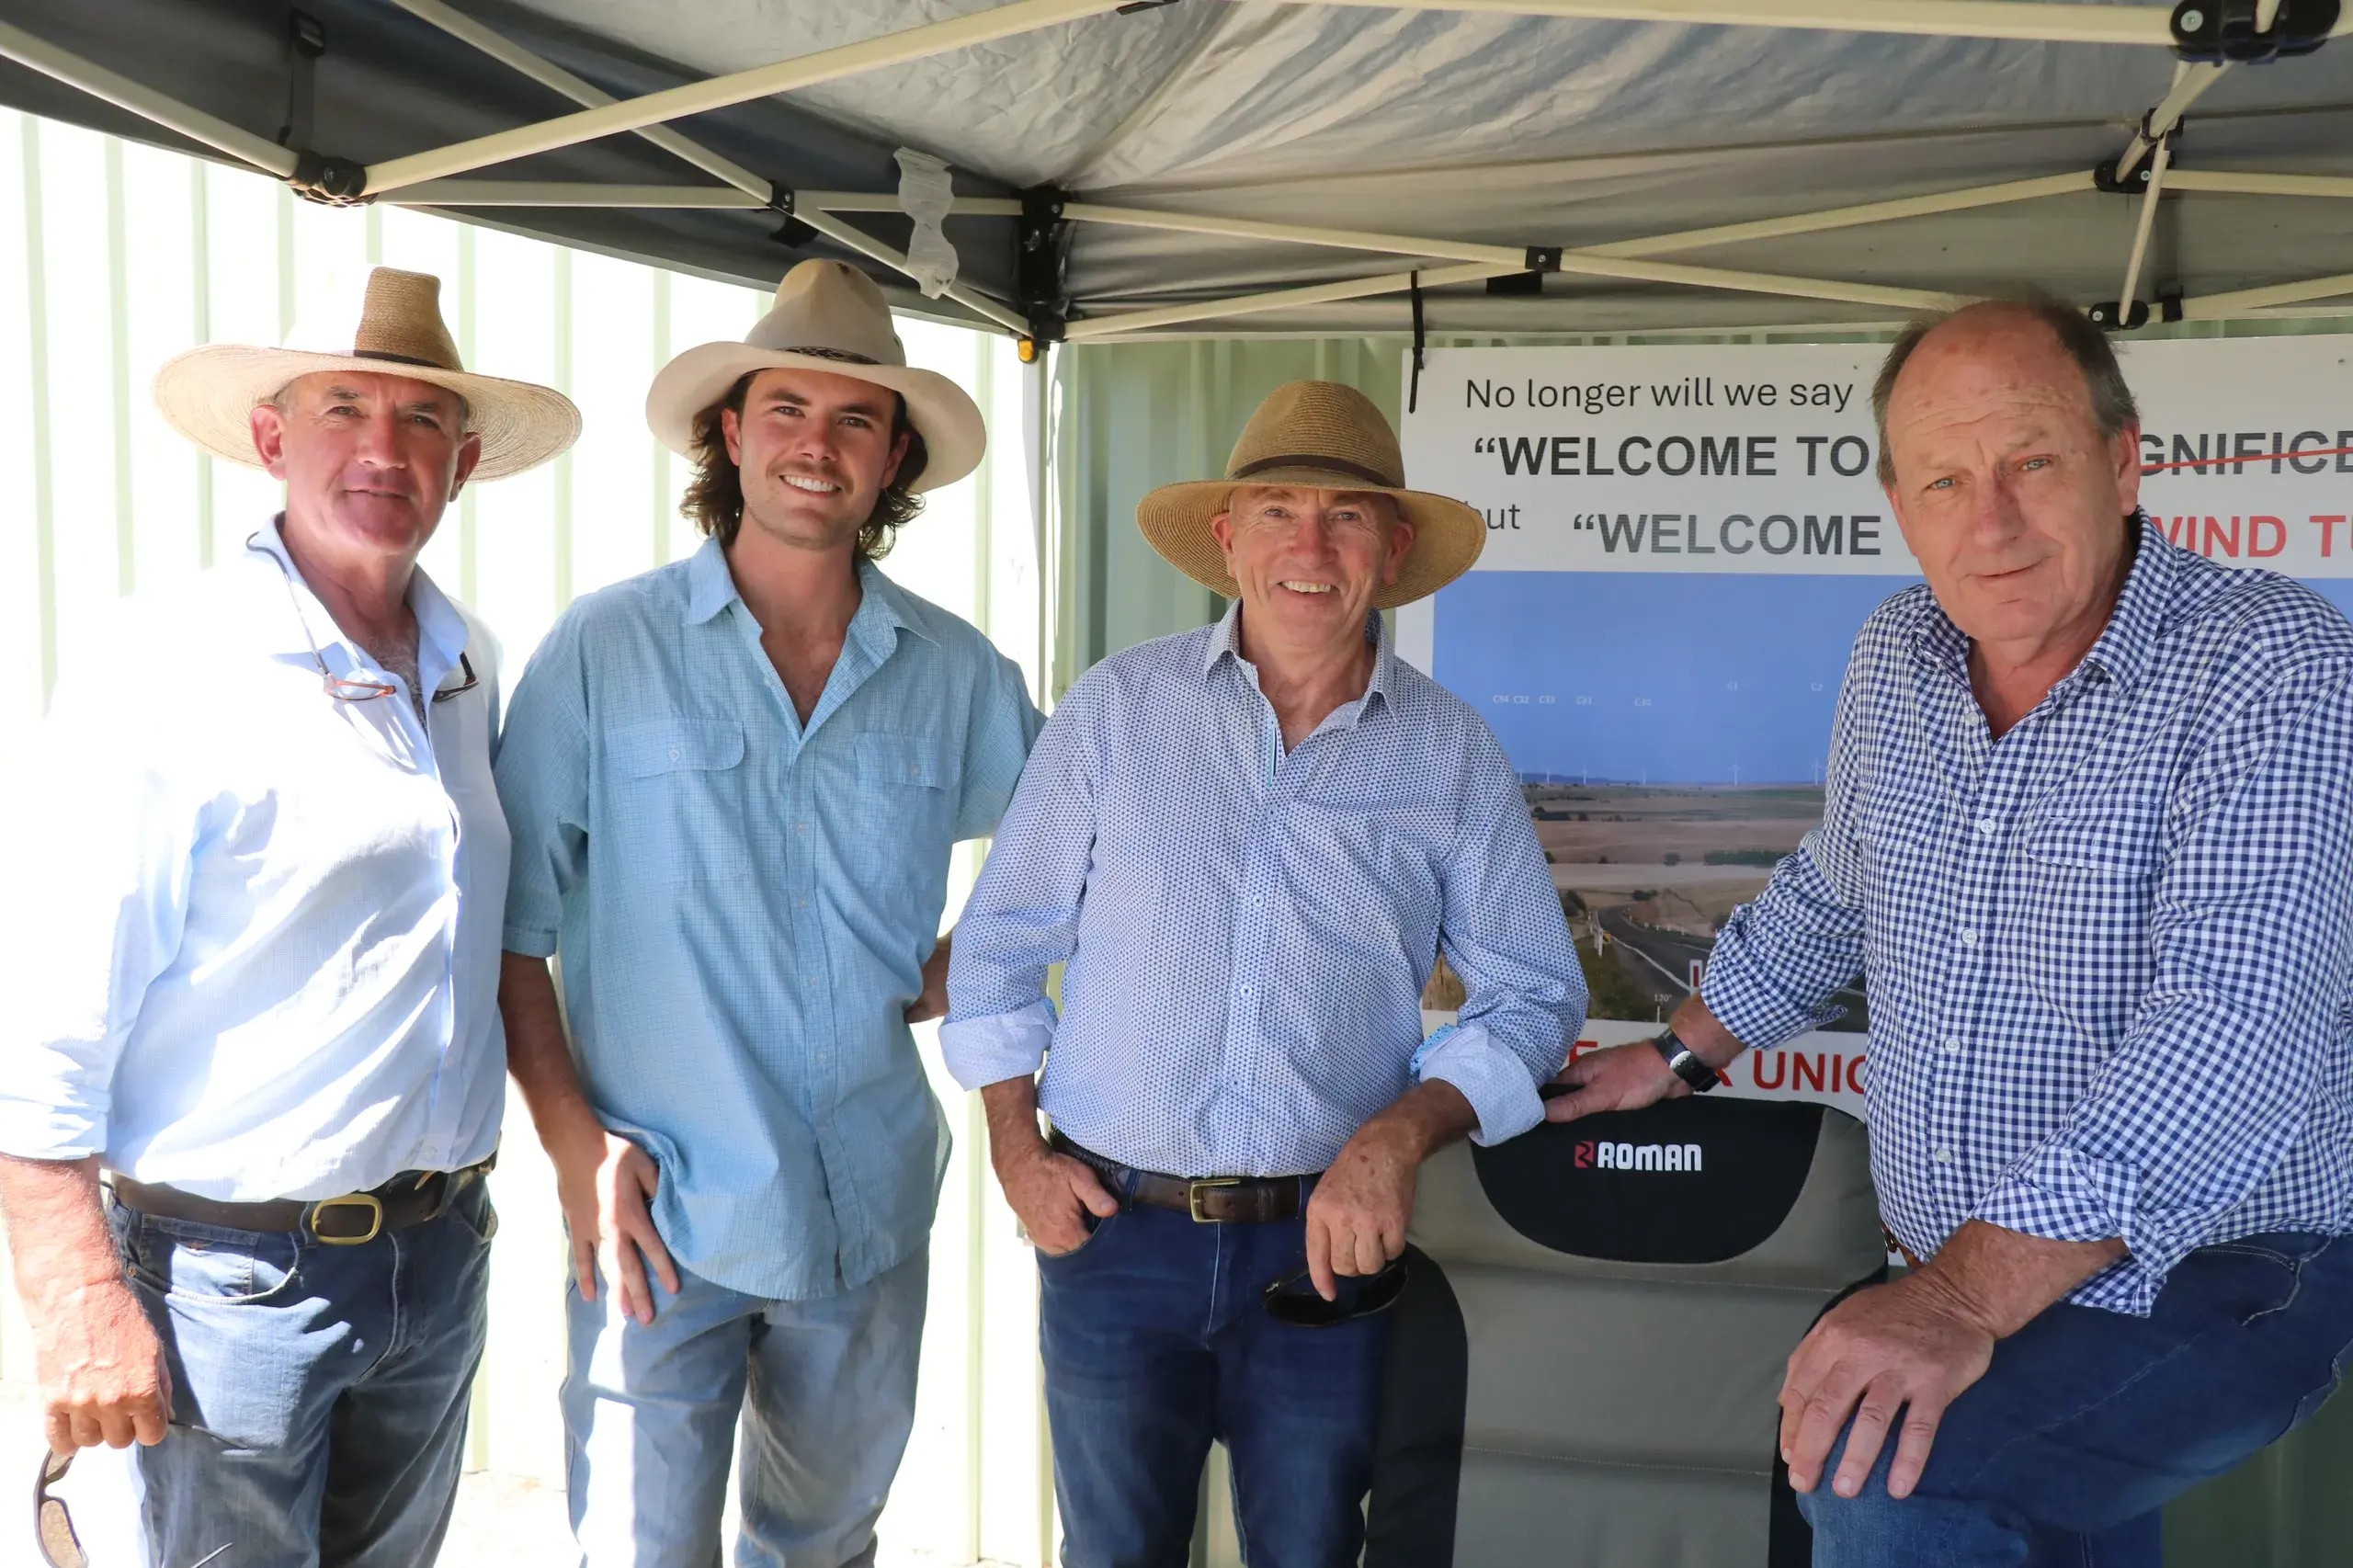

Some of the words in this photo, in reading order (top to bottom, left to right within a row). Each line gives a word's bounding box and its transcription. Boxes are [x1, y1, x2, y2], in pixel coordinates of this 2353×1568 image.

[1466, 379, 1516, 408] No
[1527, 379, 1642, 415] longer
[1651, 377, 1714, 407] will
[1724, 382, 1778, 407] we
[1789, 382, 1854, 413] say
[1474, 436, 1778, 477] “WELCOME
[1796, 436, 1870, 477] TO
[1464, 501, 1521, 529] ut
[1574, 513, 1882, 556] “WELCOME
[1597, 1142, 1702, 1172] ROMAN
